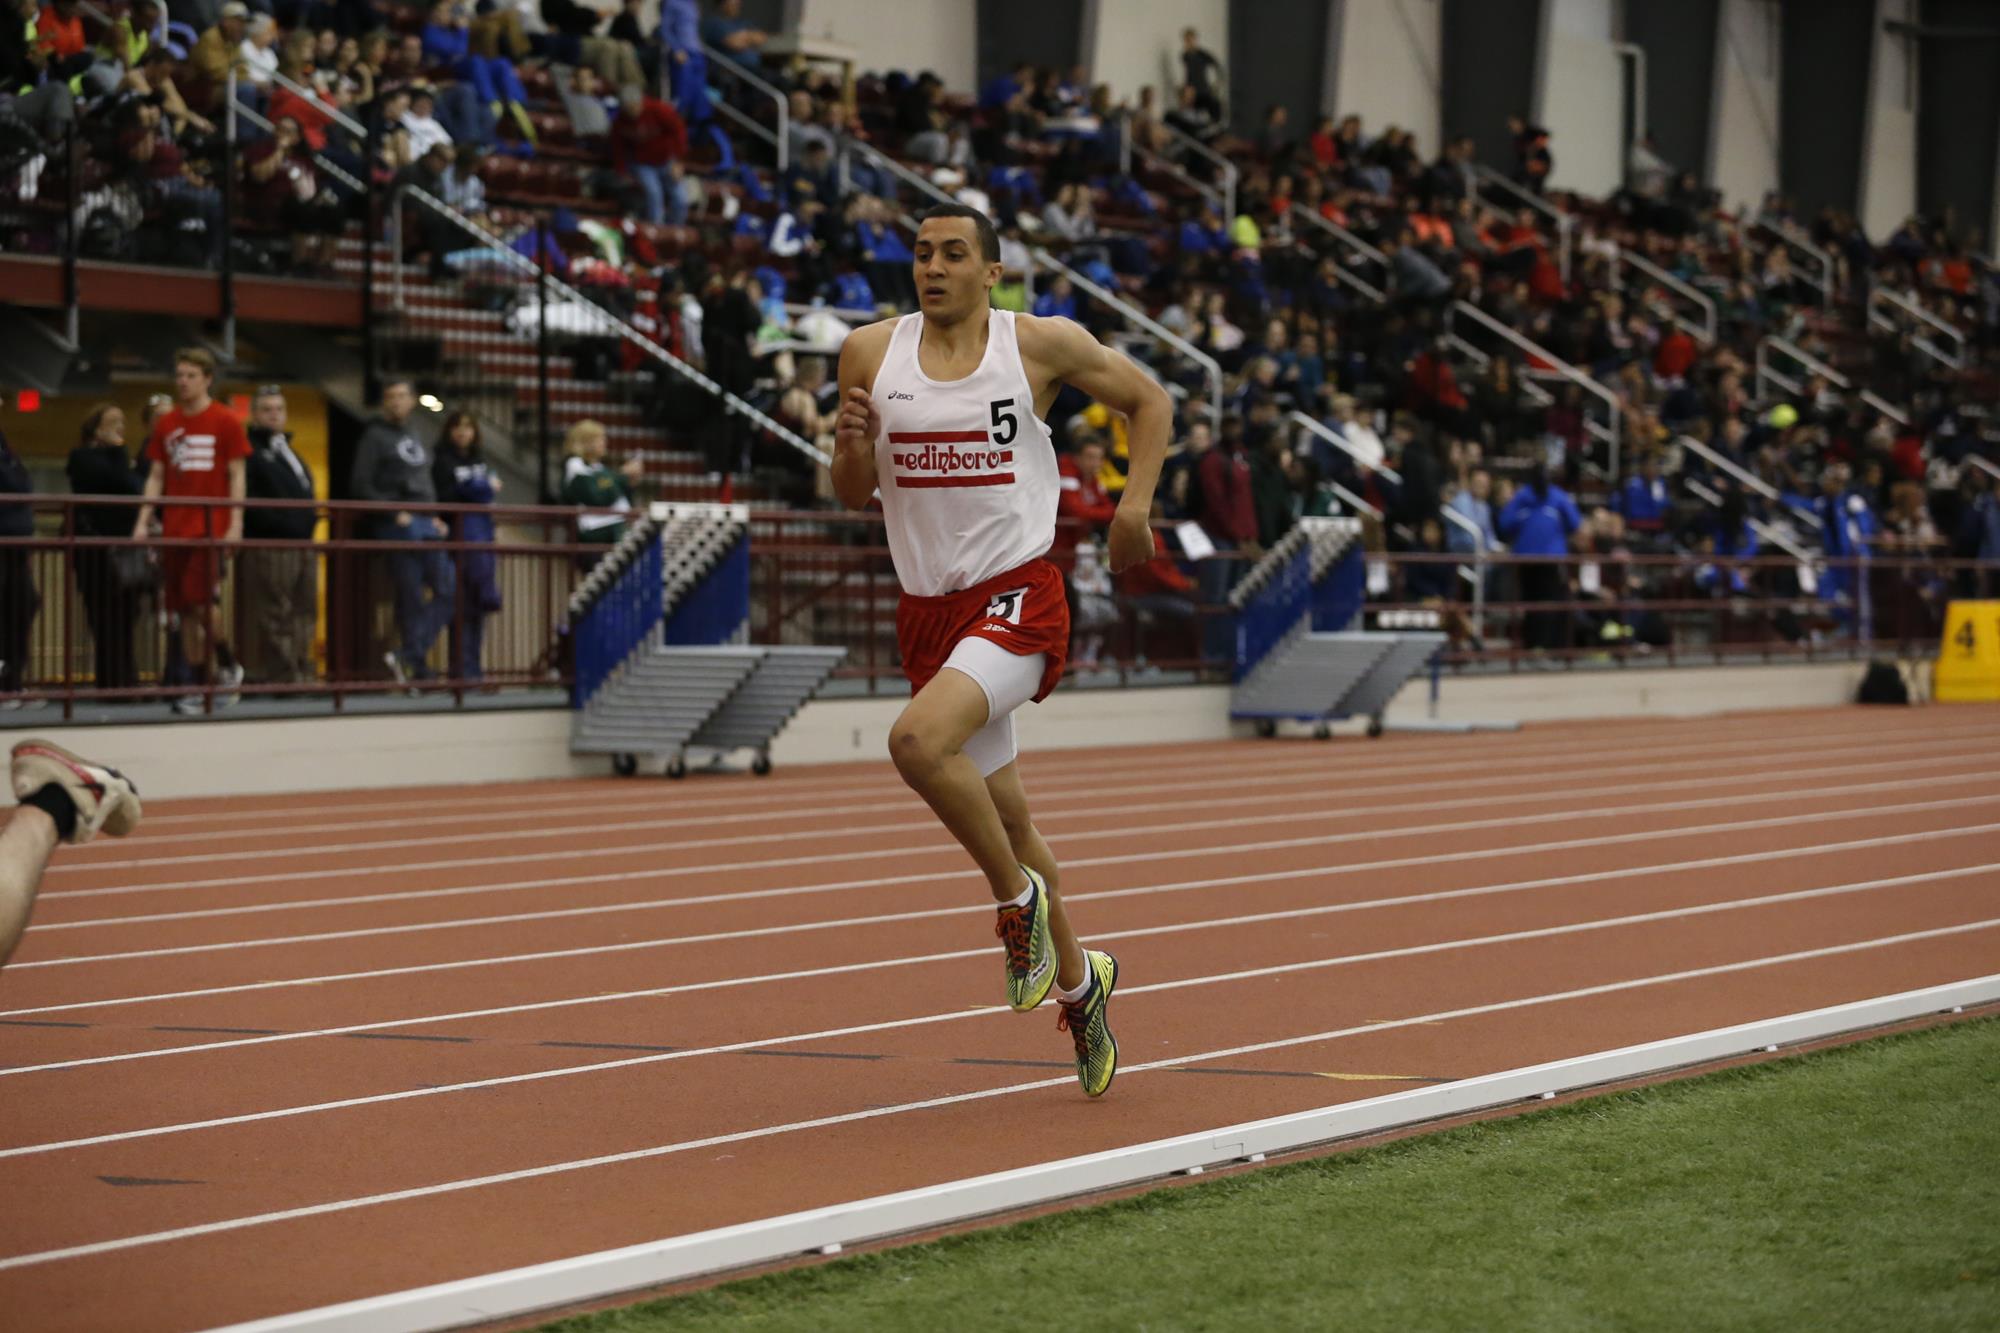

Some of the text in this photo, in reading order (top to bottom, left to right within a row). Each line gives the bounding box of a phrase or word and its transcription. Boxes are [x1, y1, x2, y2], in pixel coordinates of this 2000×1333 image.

[896, 392, 914, 401] asics
[990, 398, 1018, 445] 5
[904, 445, 1000, 474] edinboro
[1954, 618, 1976, 655] 4
